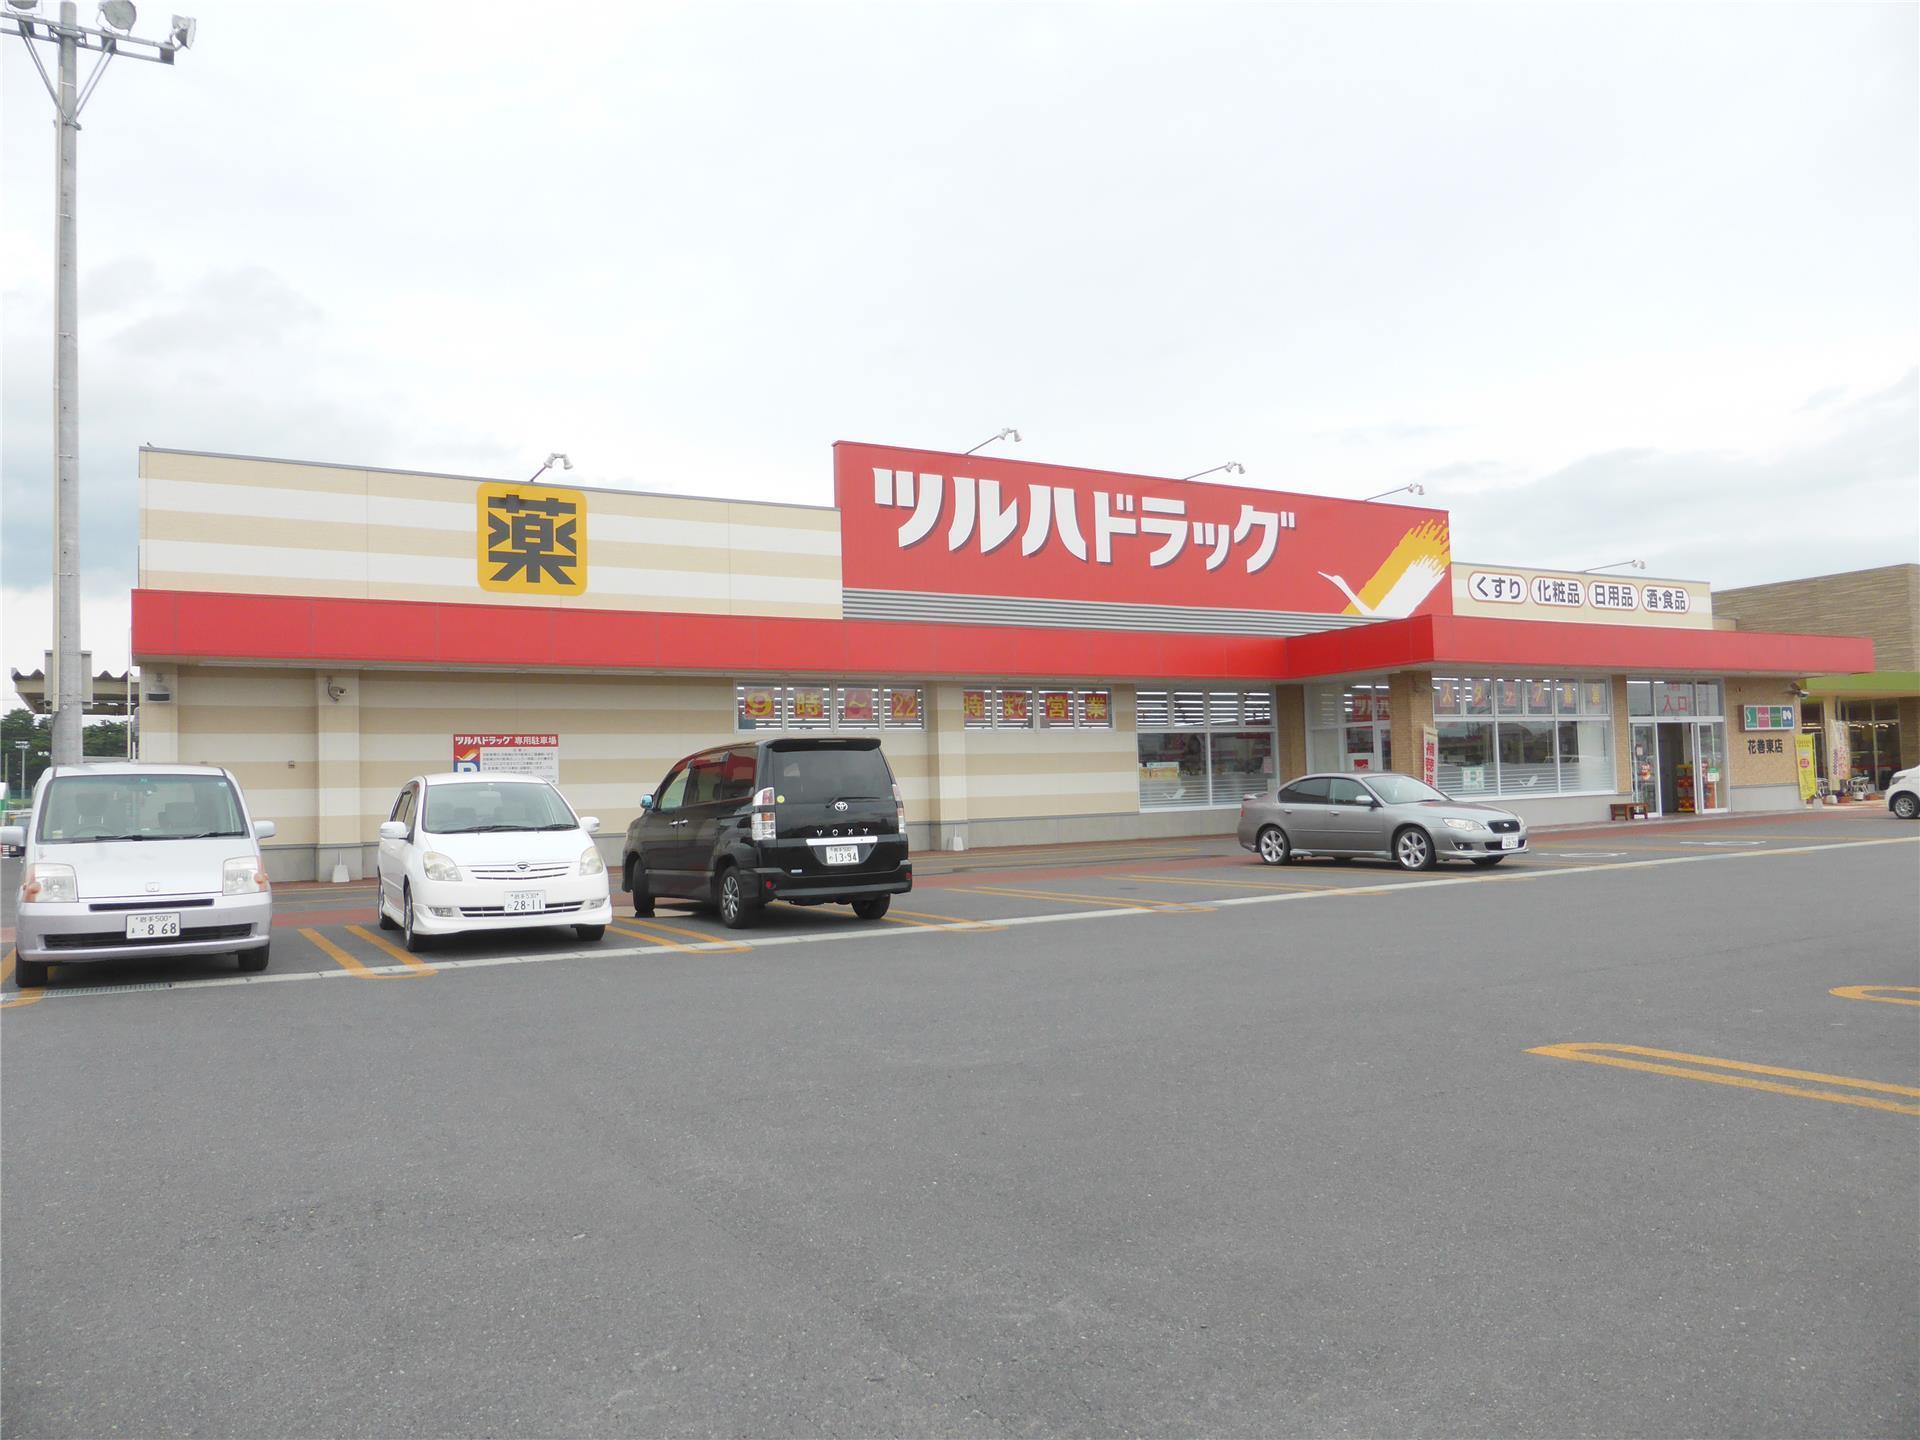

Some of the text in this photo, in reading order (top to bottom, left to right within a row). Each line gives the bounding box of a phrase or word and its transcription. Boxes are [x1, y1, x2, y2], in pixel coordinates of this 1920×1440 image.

[872, 467, 1296, 575] ツルハドラッグ
[487, 493, 577, 586] 薬
[1475, 576, 1521, 599] くすり
[1537, 579, 1580, 605] 化粧品
[1594, 584, 1633, 608] 日用品
[1663, 694, 1688, 712] 入口
[455, 736, 557, 745] ツルハドラッグ 専用駐車場
[1747, 738, 1784, 755] 花巻東店
[816, 826, 869, 837] VOXY
